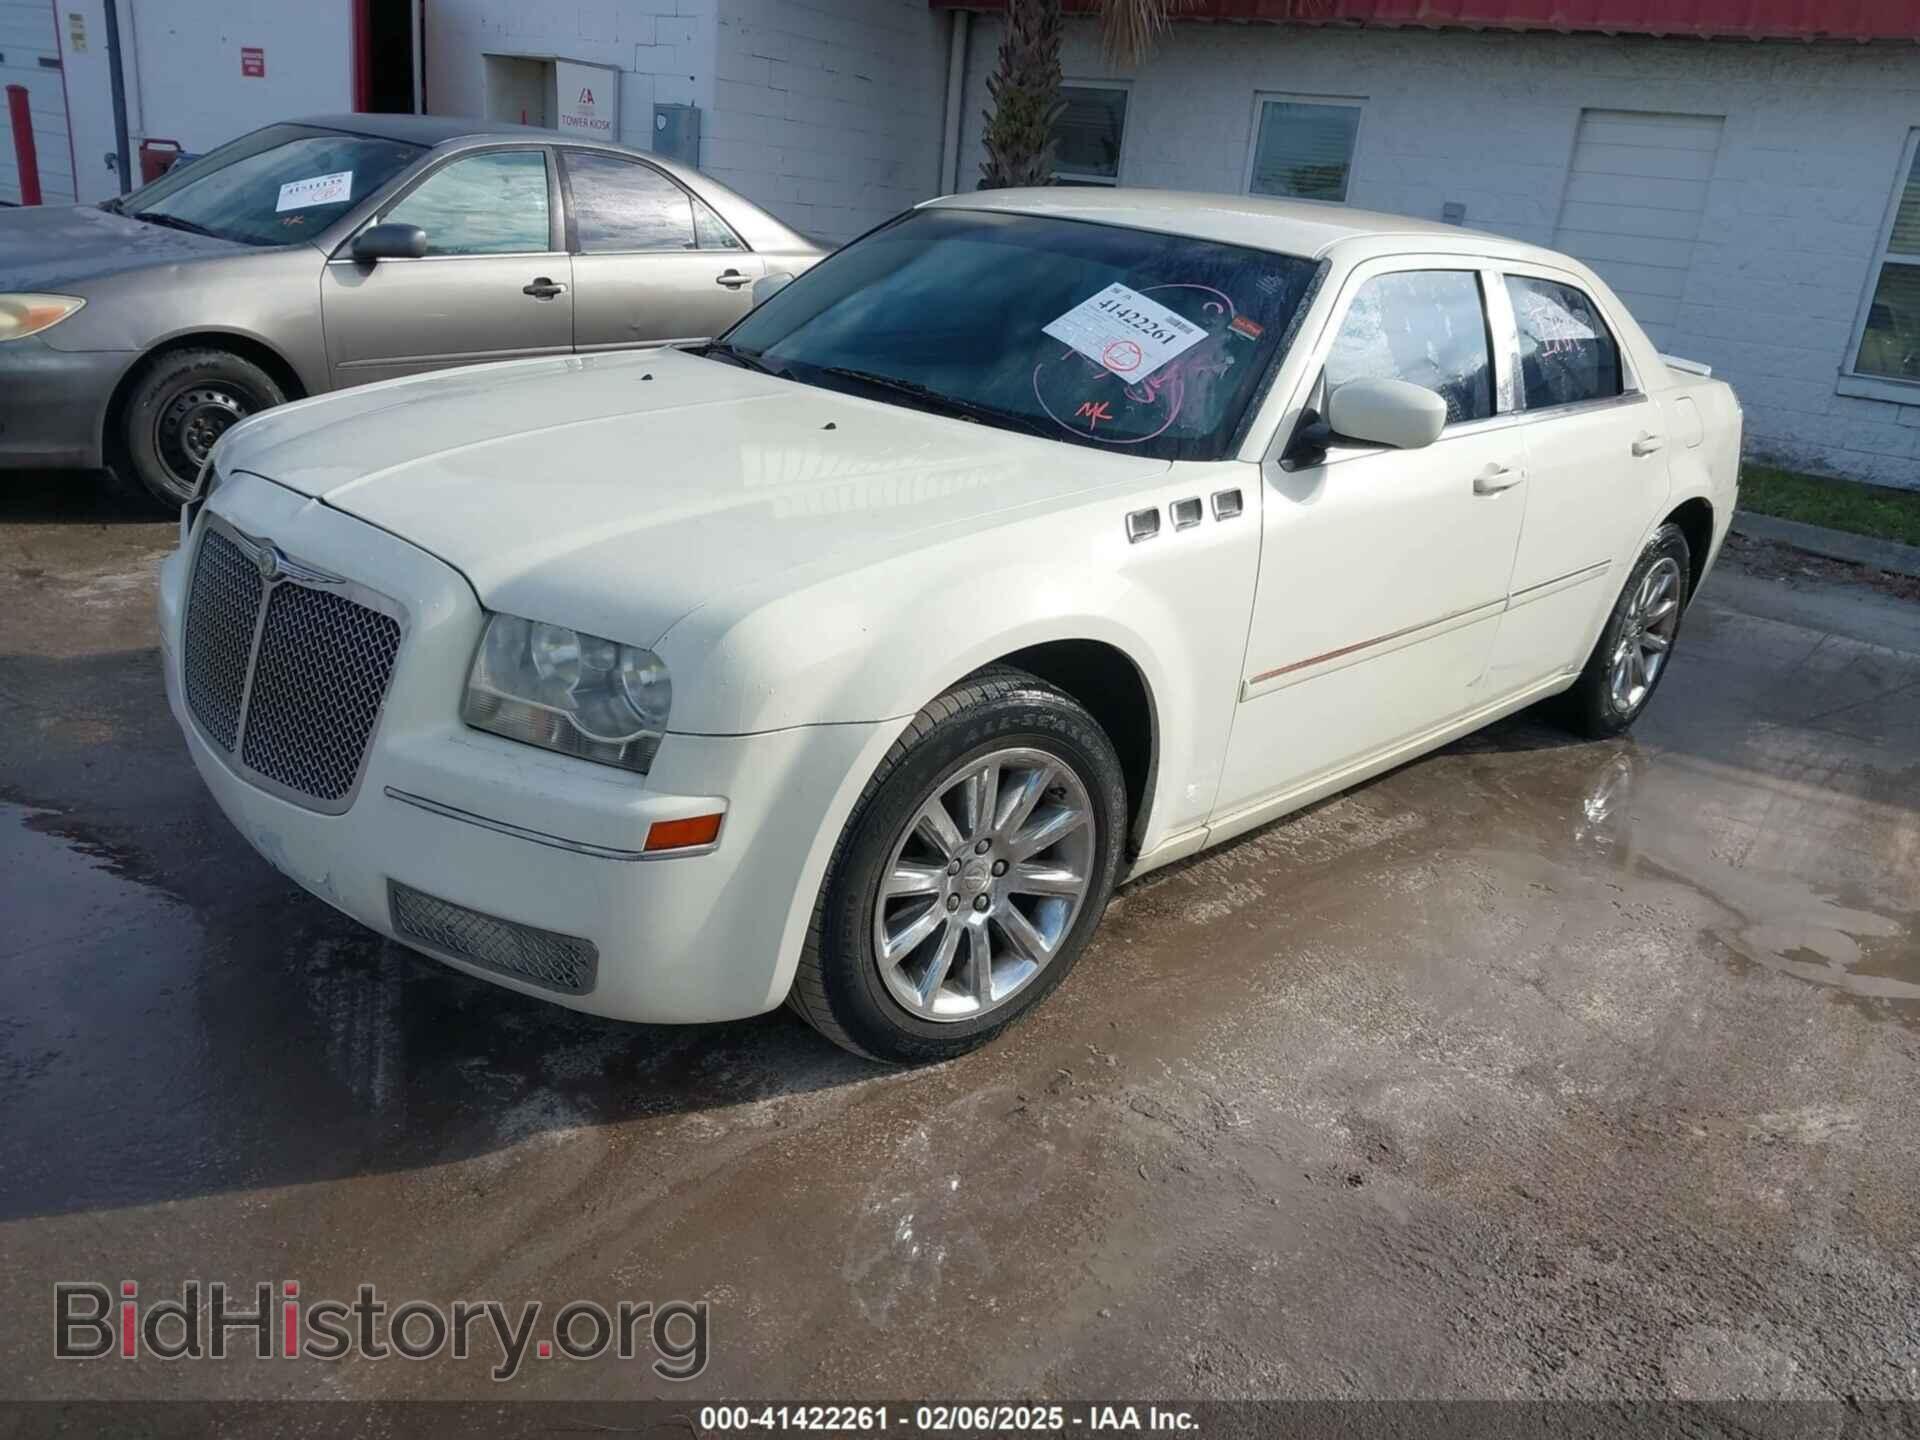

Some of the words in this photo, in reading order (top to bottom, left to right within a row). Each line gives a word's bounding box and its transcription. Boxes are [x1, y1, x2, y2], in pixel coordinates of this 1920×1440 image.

[562, 114, 588, 128] TOWER
[590, 119, 610, 130] KIOSK
[1098, 299, 1176, 345] 41422261
